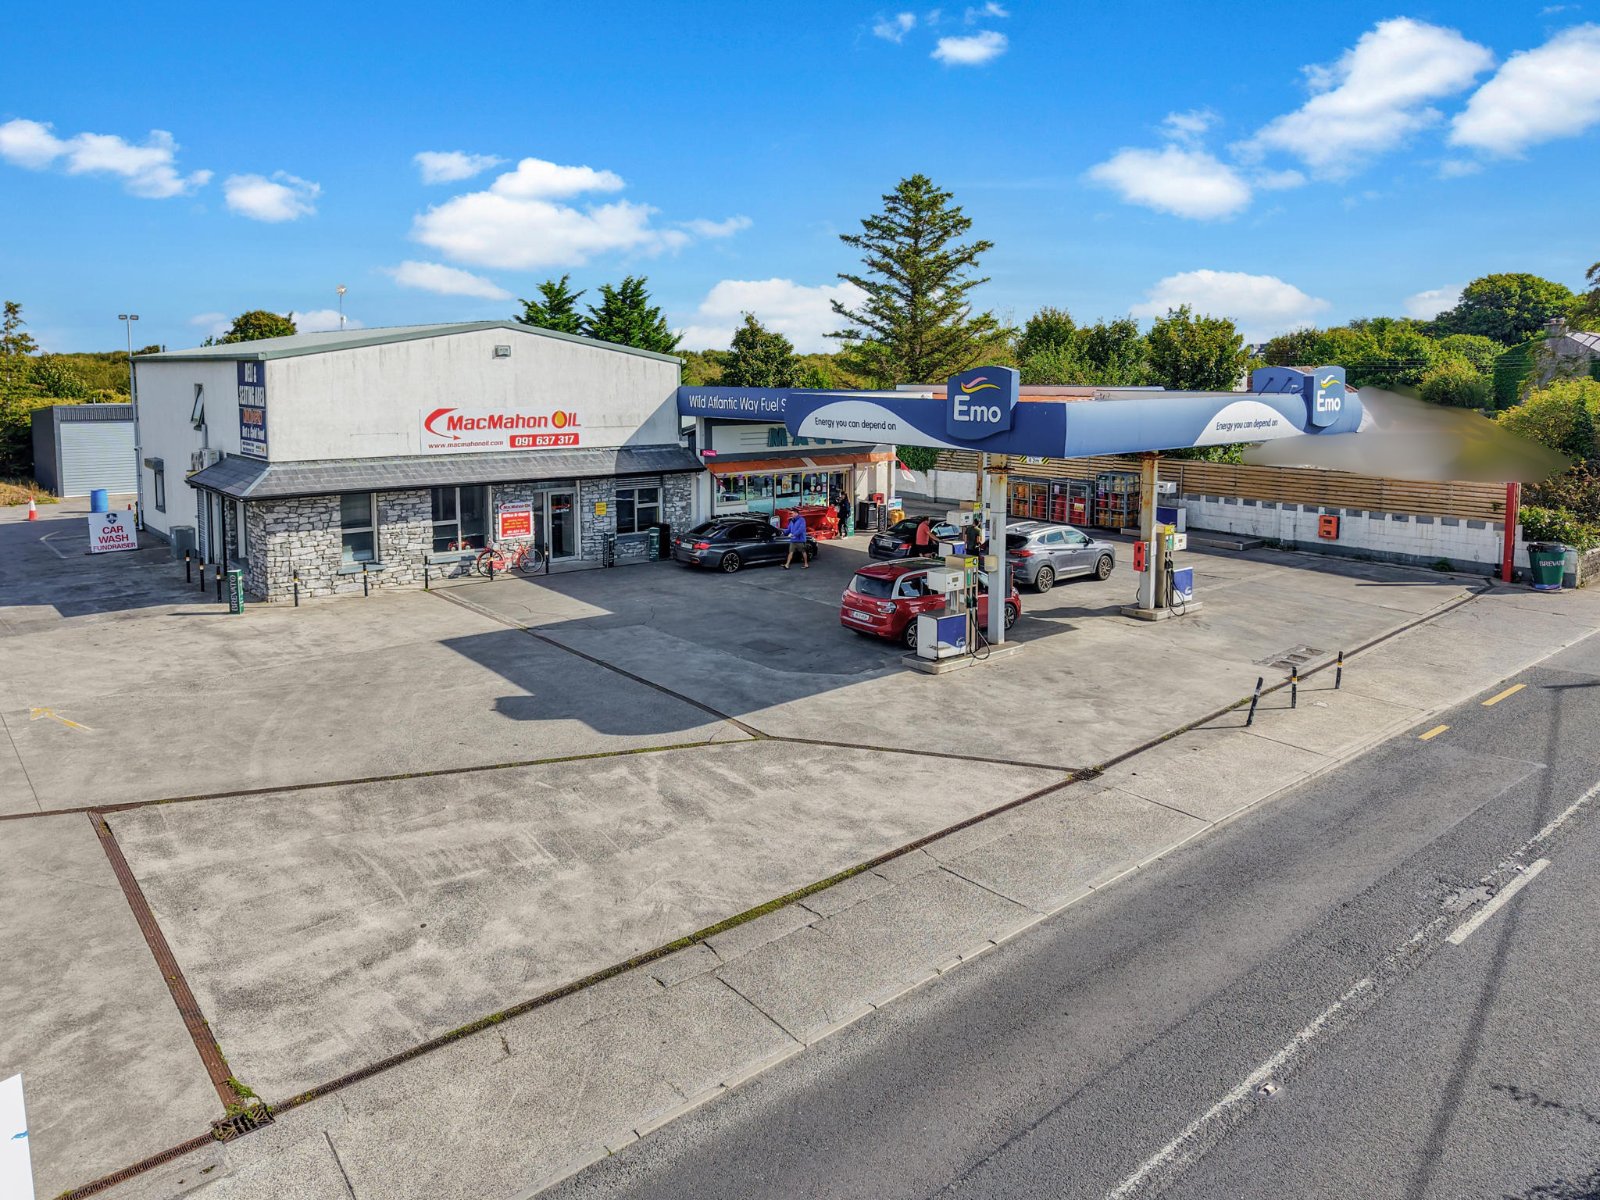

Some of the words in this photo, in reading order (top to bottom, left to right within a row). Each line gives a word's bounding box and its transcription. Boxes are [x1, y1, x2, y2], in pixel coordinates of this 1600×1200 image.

[689, 395, 706, 408] Wild
[708, 395, 737, 410] Atlantic
[740, 397, 758, 414] Way
[761, 398, 778, 412] Fuel
[1316, 390, 1341, 412] Emo
[954, 395, 1001, 422] Emo
[447, 414, 548, 430] MacMahon
[815, 417, 834, 428] Energy
[836, 420, 847, 428] you
[862, 420, 886, 431] depend
[1216, 421, 1233, 431] Energy
[1233, 422, 1243, 431] you
[1253, 418, 1271, 429] depend
[428, 440, 503, 449] www.macmahonoil.com
[515, 436, 532, 446] 091
[536, 436, 554, 445] 637
[558, 435, 574, 444] 317
[102, 526, 123, 534] CAR
[98, 534, 129, 543] WASH
[93, 542, 136, 551] FUNDRAISER
[230, 575, 238, 611] BREVATO
